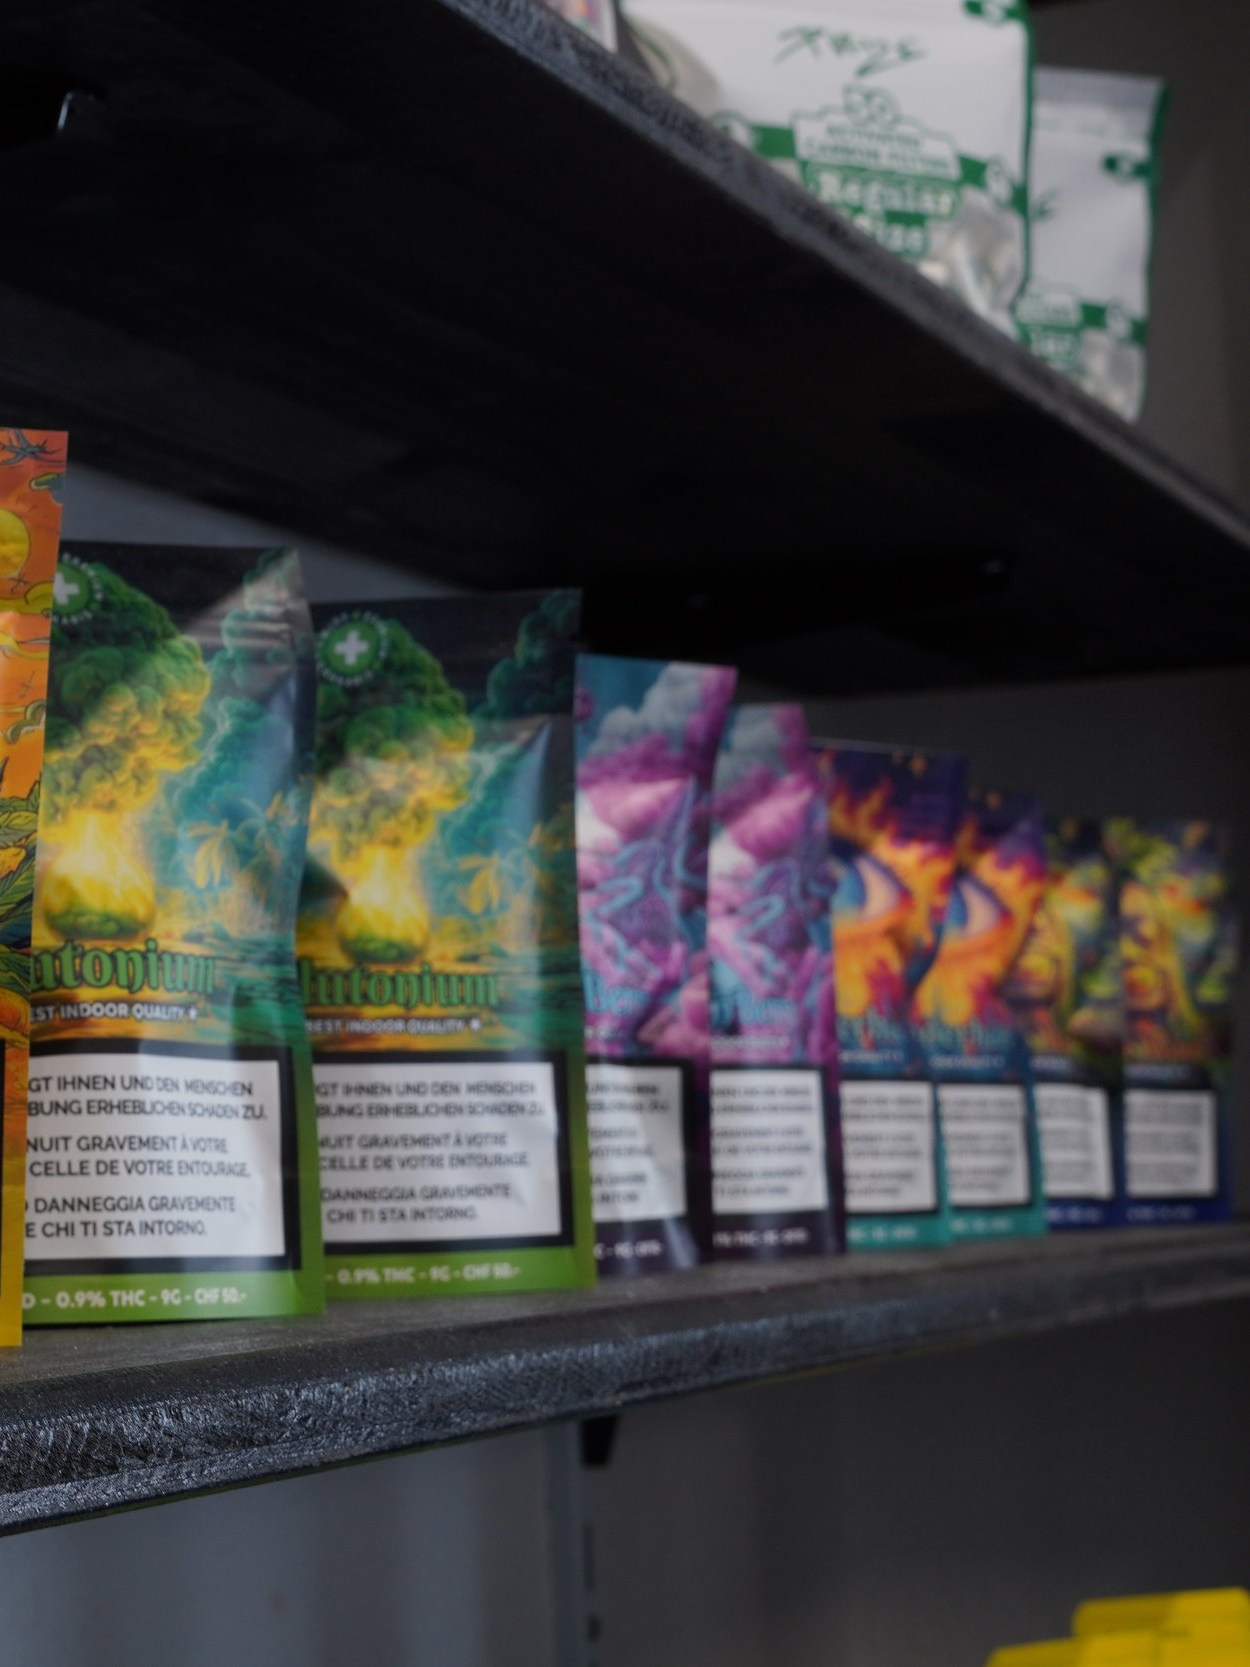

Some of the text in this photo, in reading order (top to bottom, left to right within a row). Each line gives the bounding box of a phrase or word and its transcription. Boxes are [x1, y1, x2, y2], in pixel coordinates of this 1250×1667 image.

[60, 1002, 129, 1019] INDOOR
[132, 1002, 185, 1020] QUALITY
[57, 1075, 115, 1092] IHNEN
[121, 1075, 153, 1092] UND
[76, 1135, 177, 1152] GRAVEMENT
[191, 1136, 228, 1154] VOTRE
[29, 1160, 90, 1177] CELLE
[96, 1160, 119, 1176] DE
[123, 1159, 173, 1176] VOTRE
[34, 1196, 236, 1213] DANNEGGIA GRAVEMENTE
[41, 1221, 75, 1238] CHI
[80, 1221, 97, 1237] TI
[102, 1220, 135, 1237] STA
[56, 1291, 105, 1309] 0.9%
[110, 1289, 146, 1307] THC
[160, 1288, 182, 1306] 9G
[194, 1287, 220, 1304] CHF
